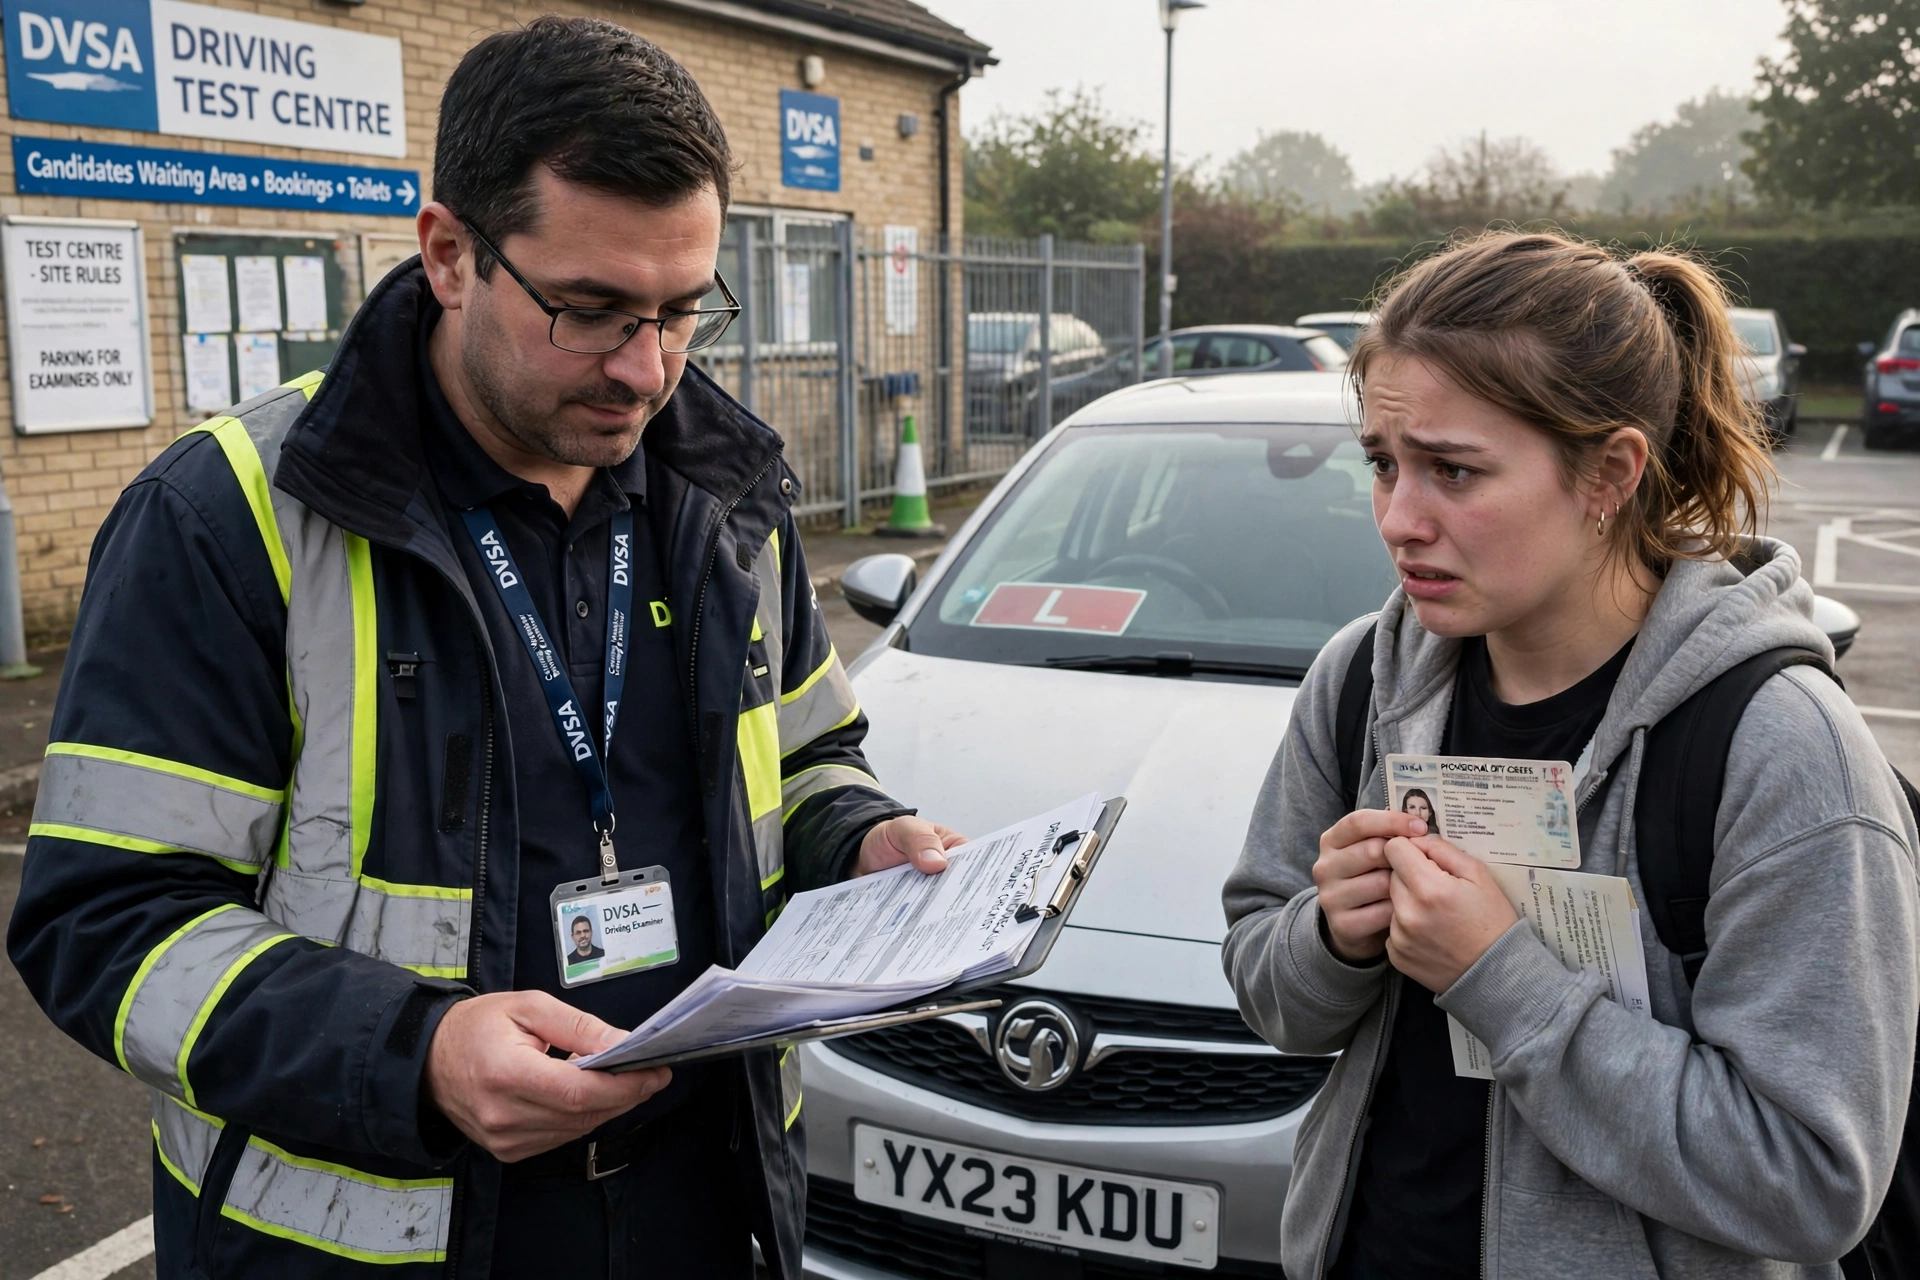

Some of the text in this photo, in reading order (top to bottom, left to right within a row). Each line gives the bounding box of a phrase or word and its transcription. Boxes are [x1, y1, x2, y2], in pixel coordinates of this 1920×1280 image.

[19, 11, 143, 74] DVSA
[171, 22, 316, 79] DRIVING
[173, 77, 391, 136] TEST CENTRE
[786, 108, 836, 146] DVSA
[27, 151, 392, 203] Candidates Waiting Area Bookings Toilets
[25, 240, 123, 260] TEST CENTRE
[40, 265, 72, 283] SITE
[76, 266, 121, 284] RULES
[40, 349, 121, 367] PARKING FOR
[29, 371, 133, 389] EXAMINERS ONLY
[481, 530, 518, 589] DVSA
[613, 534, 629, 586] DVSA
[649, 601, 672, 628] D
[1033, 589, 1069, 624] L
[557, 700, 592, 762] DVSA
[603, 903, 641, 922] DVSA
[632, 918, 664, 930] Examiner
[883, 1139, 1184, 1250] YX23 KDU
